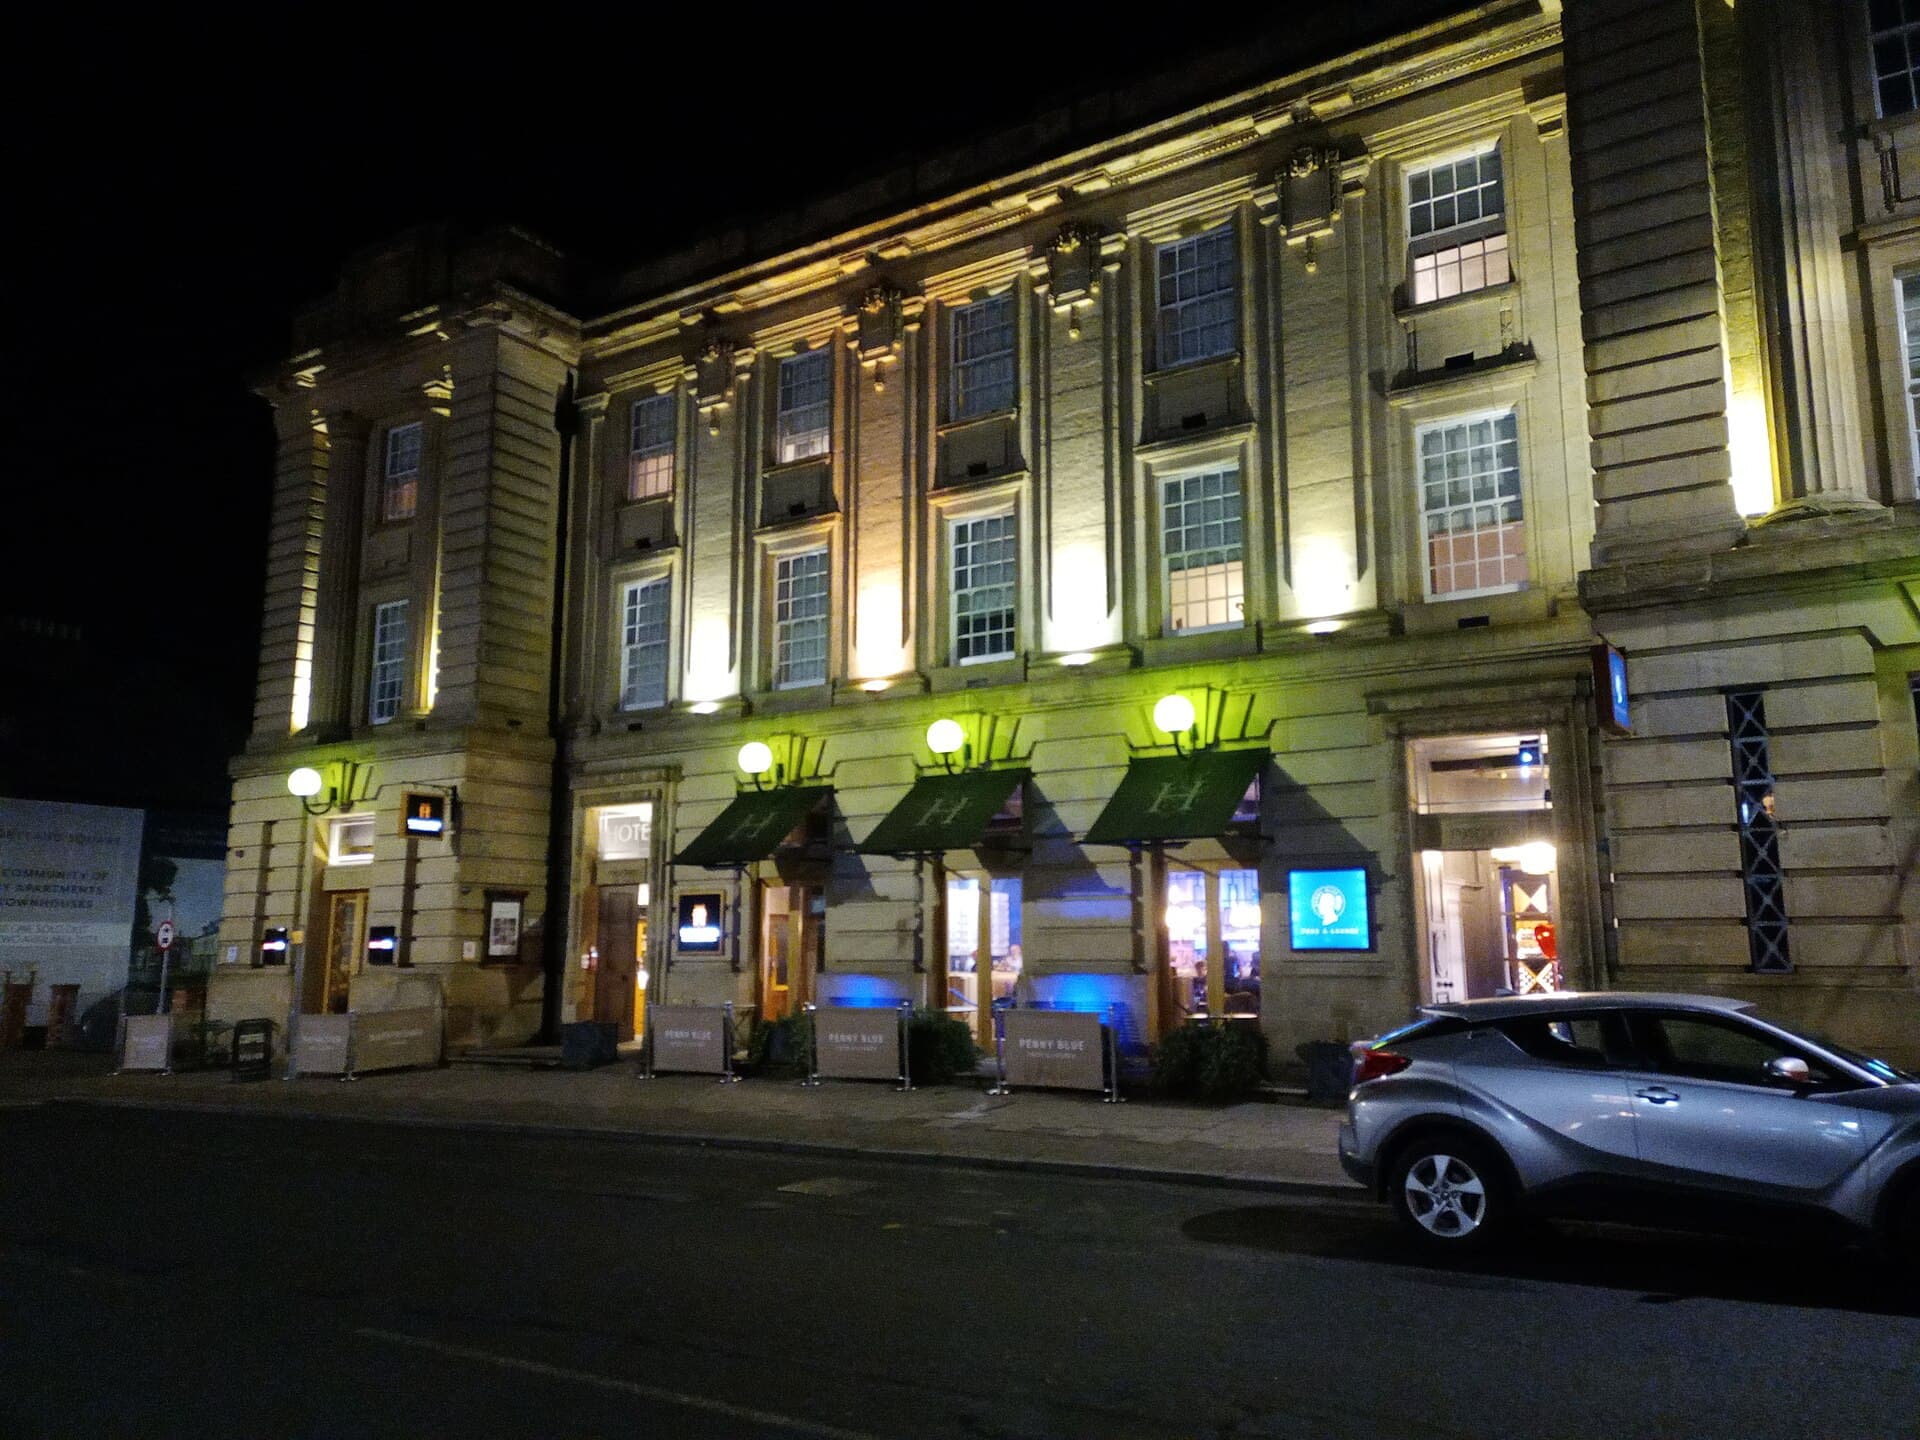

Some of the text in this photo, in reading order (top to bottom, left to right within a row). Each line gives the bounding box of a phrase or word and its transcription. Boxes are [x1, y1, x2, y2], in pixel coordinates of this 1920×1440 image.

[1145, 780, 1204, 813] H
[916, 797, 969, 826] H
[2, 868, 109, 881] COMMUNITY OF
[15, 883, 103, 895] APARTMENTS
[828, 1033, 884, 1044] PENNY BLUE
[1019, 1038, 1085, 1052] PENNY BLUE
